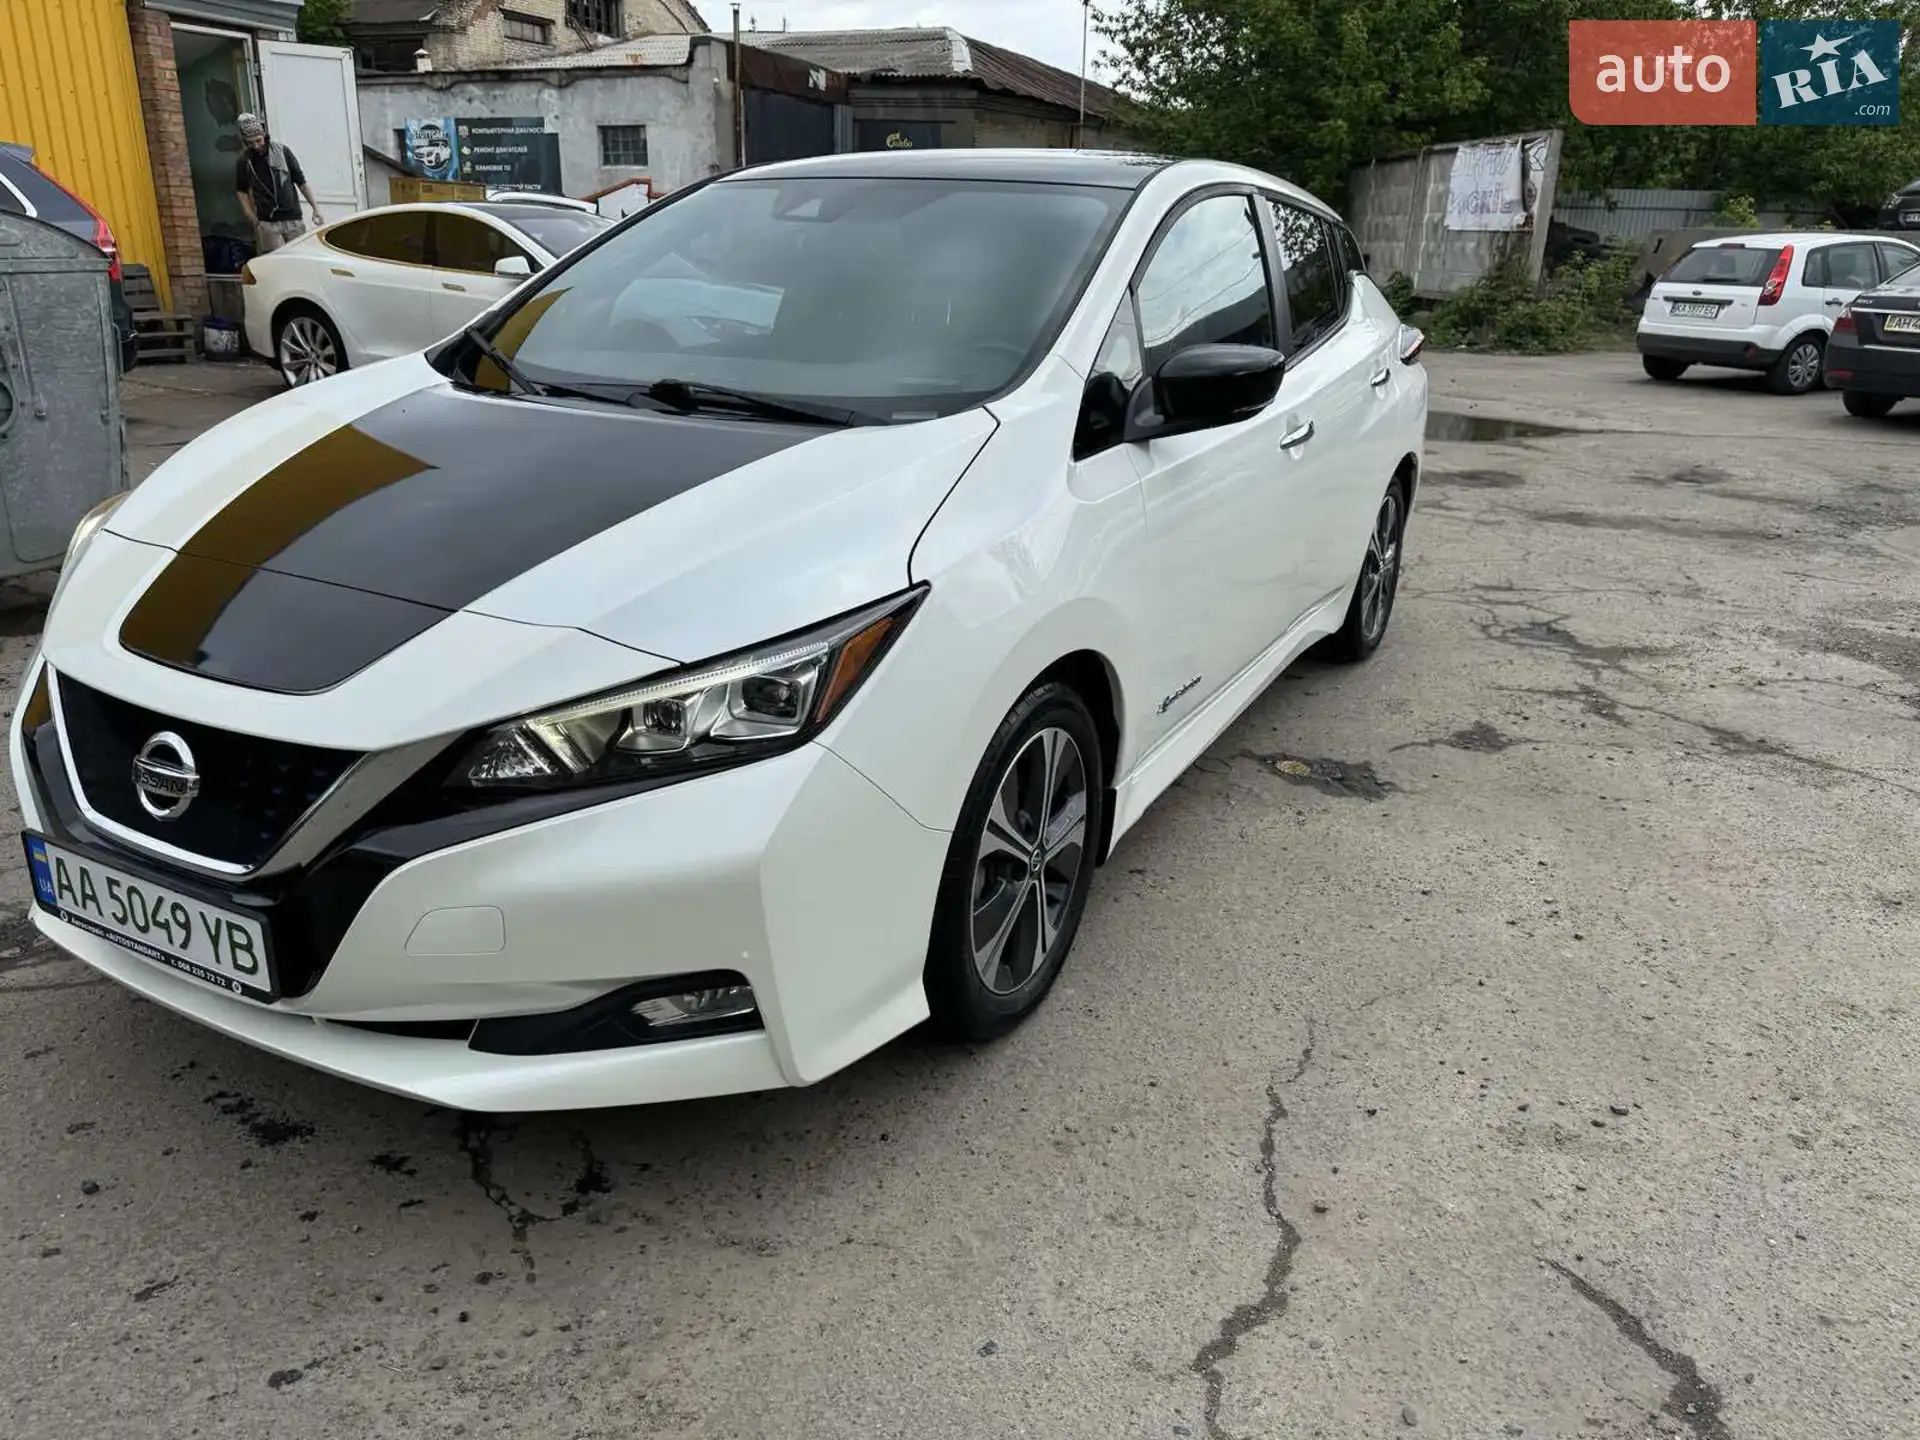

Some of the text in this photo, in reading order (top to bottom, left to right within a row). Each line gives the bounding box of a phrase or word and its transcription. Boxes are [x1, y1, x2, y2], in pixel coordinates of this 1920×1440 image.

[413, 131, 448, 140] STUTTGART
[38, 877, 55, 897] UA
[54, 857, 259, 976] AA 5049 YB
